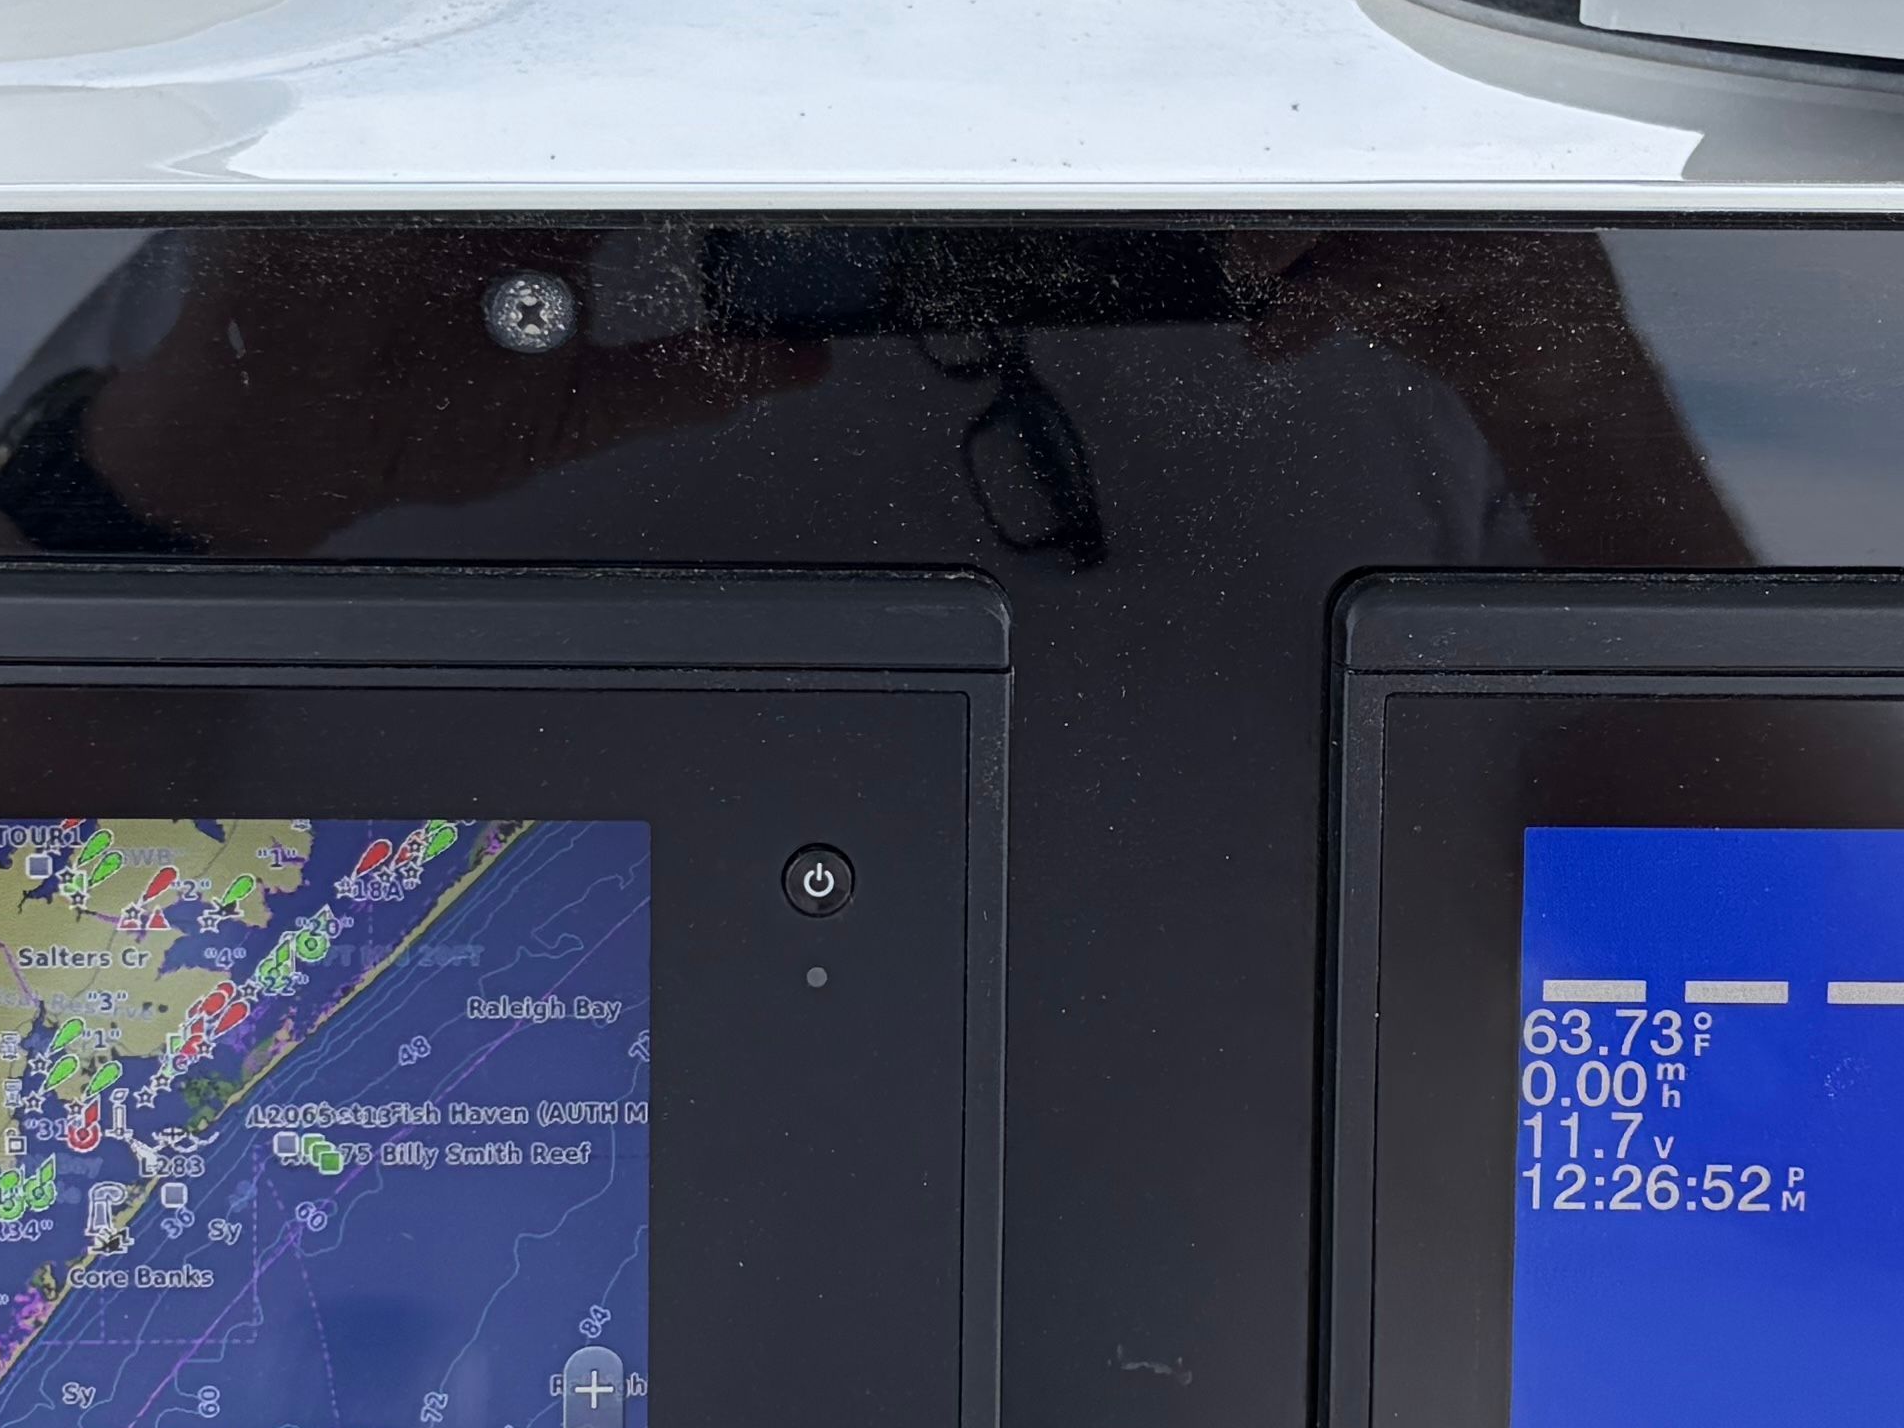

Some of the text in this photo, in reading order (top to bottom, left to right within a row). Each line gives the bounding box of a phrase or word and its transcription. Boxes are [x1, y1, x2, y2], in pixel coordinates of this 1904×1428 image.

[17, 947, 150, 968] Salters Cr
[467, 996, 622, 1023] Raleigh Bay
[1523, 1009, 1684, 1056] 63.73
[1522, 1060, 1647, 1108] 0.00
[450, 1103, 529, 1125] Haven
[1523, 1112, 1644, 1160] 11.7
[382, 1143, 591, 1170] Billy Smith Reef
[1522, 1163, 1771, 1212] 12:26:52
[69, 1264, 214, 1288] Core Banks
